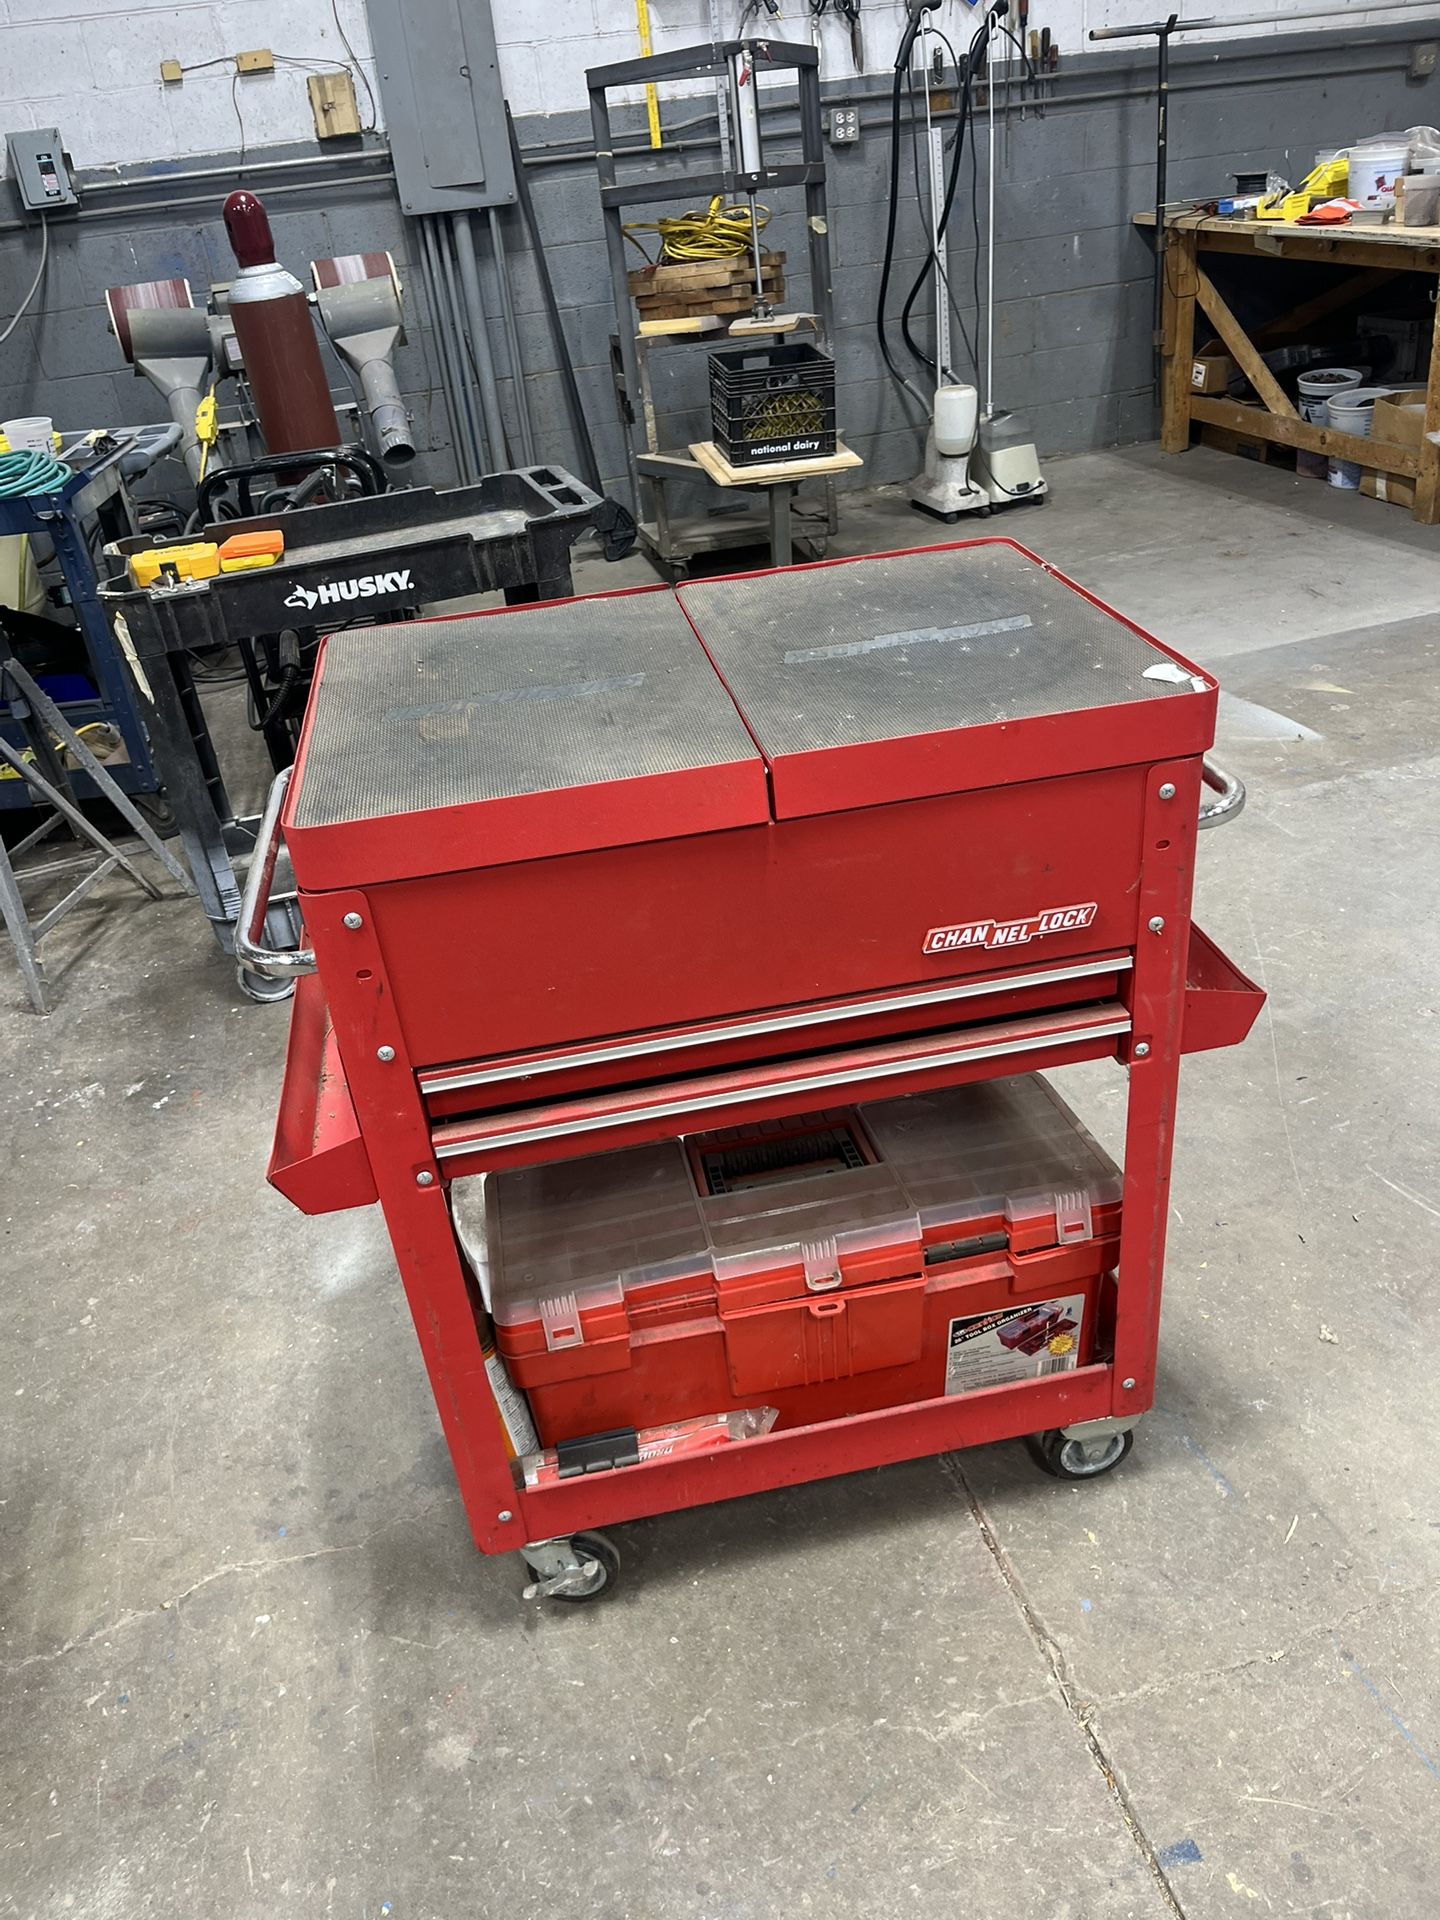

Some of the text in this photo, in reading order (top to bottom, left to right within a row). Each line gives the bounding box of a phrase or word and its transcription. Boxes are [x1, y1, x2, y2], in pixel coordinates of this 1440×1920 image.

[751, 440, 820, 455] national dairy
[965, 1330, 982, 1339] TOOL
[982, 1323, 996, 1331] BOX
[997, 1307, 1032, 1325] ORGANIZER
